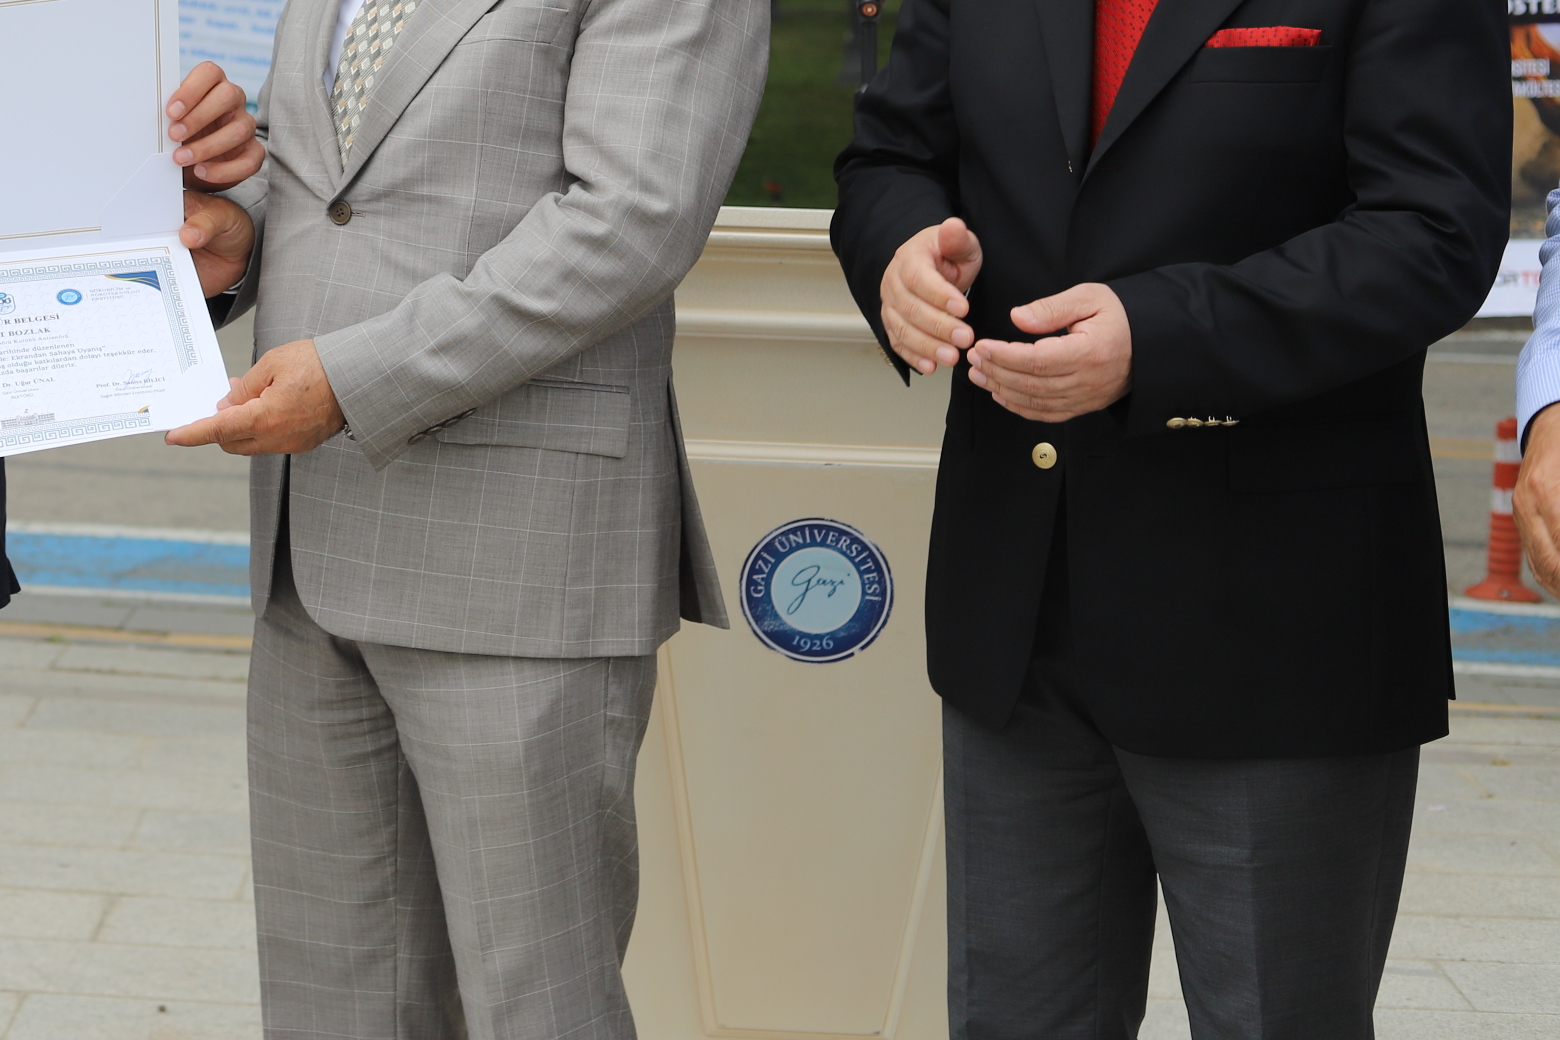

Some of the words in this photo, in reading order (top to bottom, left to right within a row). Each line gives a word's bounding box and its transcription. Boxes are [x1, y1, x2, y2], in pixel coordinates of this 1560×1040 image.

[14, 313, 60, 324] BELGESİ
[8, 327, 51, 337] BOZLAK
[32, 343, 75, 352] düzenlenen
[7, 361, 32, 372] olduğu
[34, 356, 77, 366] katkılardan
[79, 353, 102, 362] dolayı
[103, 349, 135, 359] teşekkür
[11, 351, 47, 361] Ekrandan
[16, 364, 50, 375] başarılar
[750, 551, 776, 598] GAZİ
[774, 526, 882, 602] ÜNİVERSİTESİ
[792, 635, 834, 652] 1926
